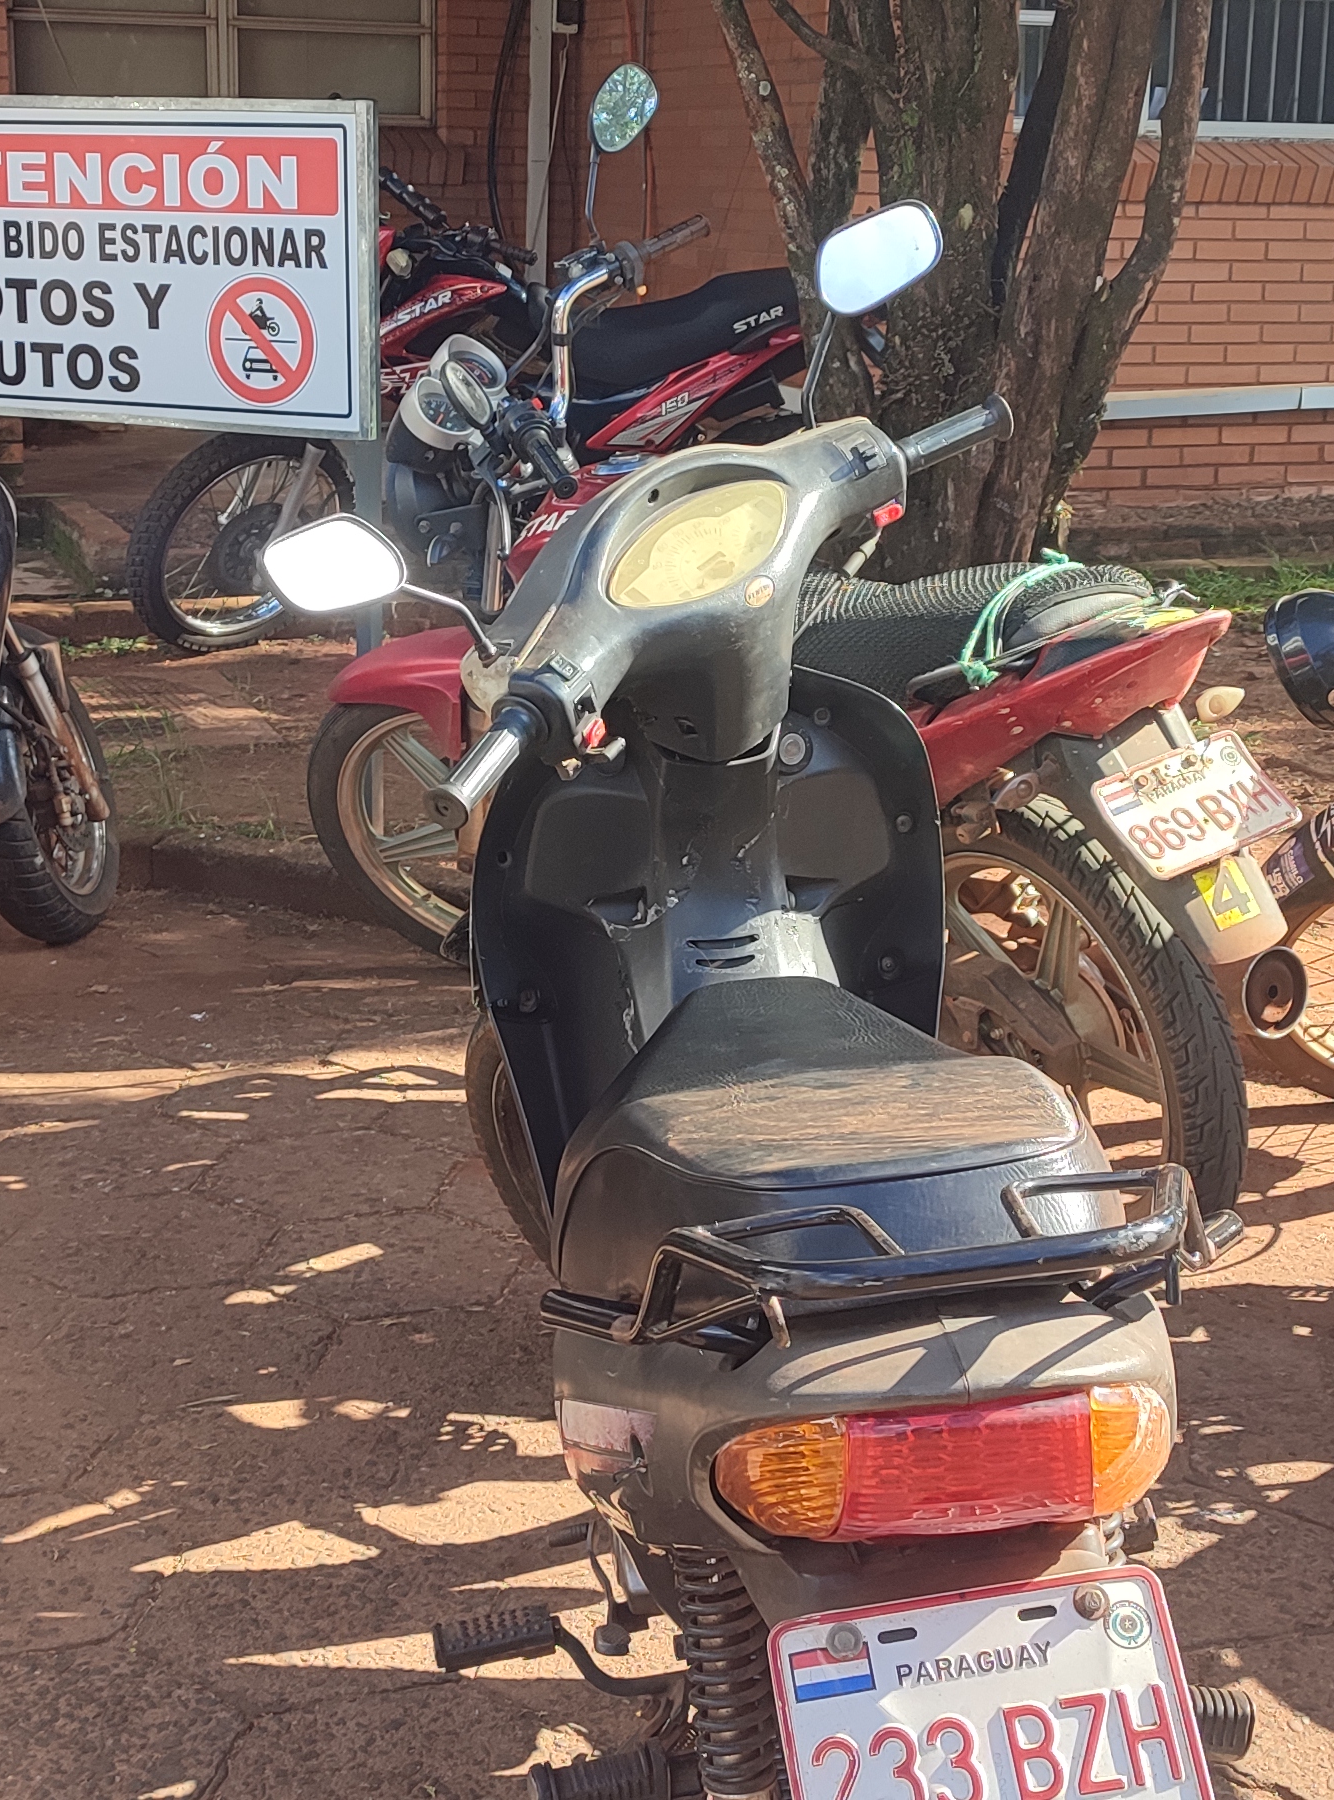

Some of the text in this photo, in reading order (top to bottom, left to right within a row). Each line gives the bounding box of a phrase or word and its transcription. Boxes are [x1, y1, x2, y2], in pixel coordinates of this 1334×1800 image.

[98, 222, 328, 269] ESTACIONAR
[133, 282, 171, 330] Y
[397, 290, 452, 324] STAR
[733, 305, 784, 334] STAR
[661, 391, 689, 416] 150
[1128, 775, 1282, 859] 869 BXH
[1211, 860, 1253, 916] 4
[896, 1640, 1053, 1687] PARAGUAY
[811, 1715, 987, 1800] 233
[1002, 1683, 1183, 1800] BZH
